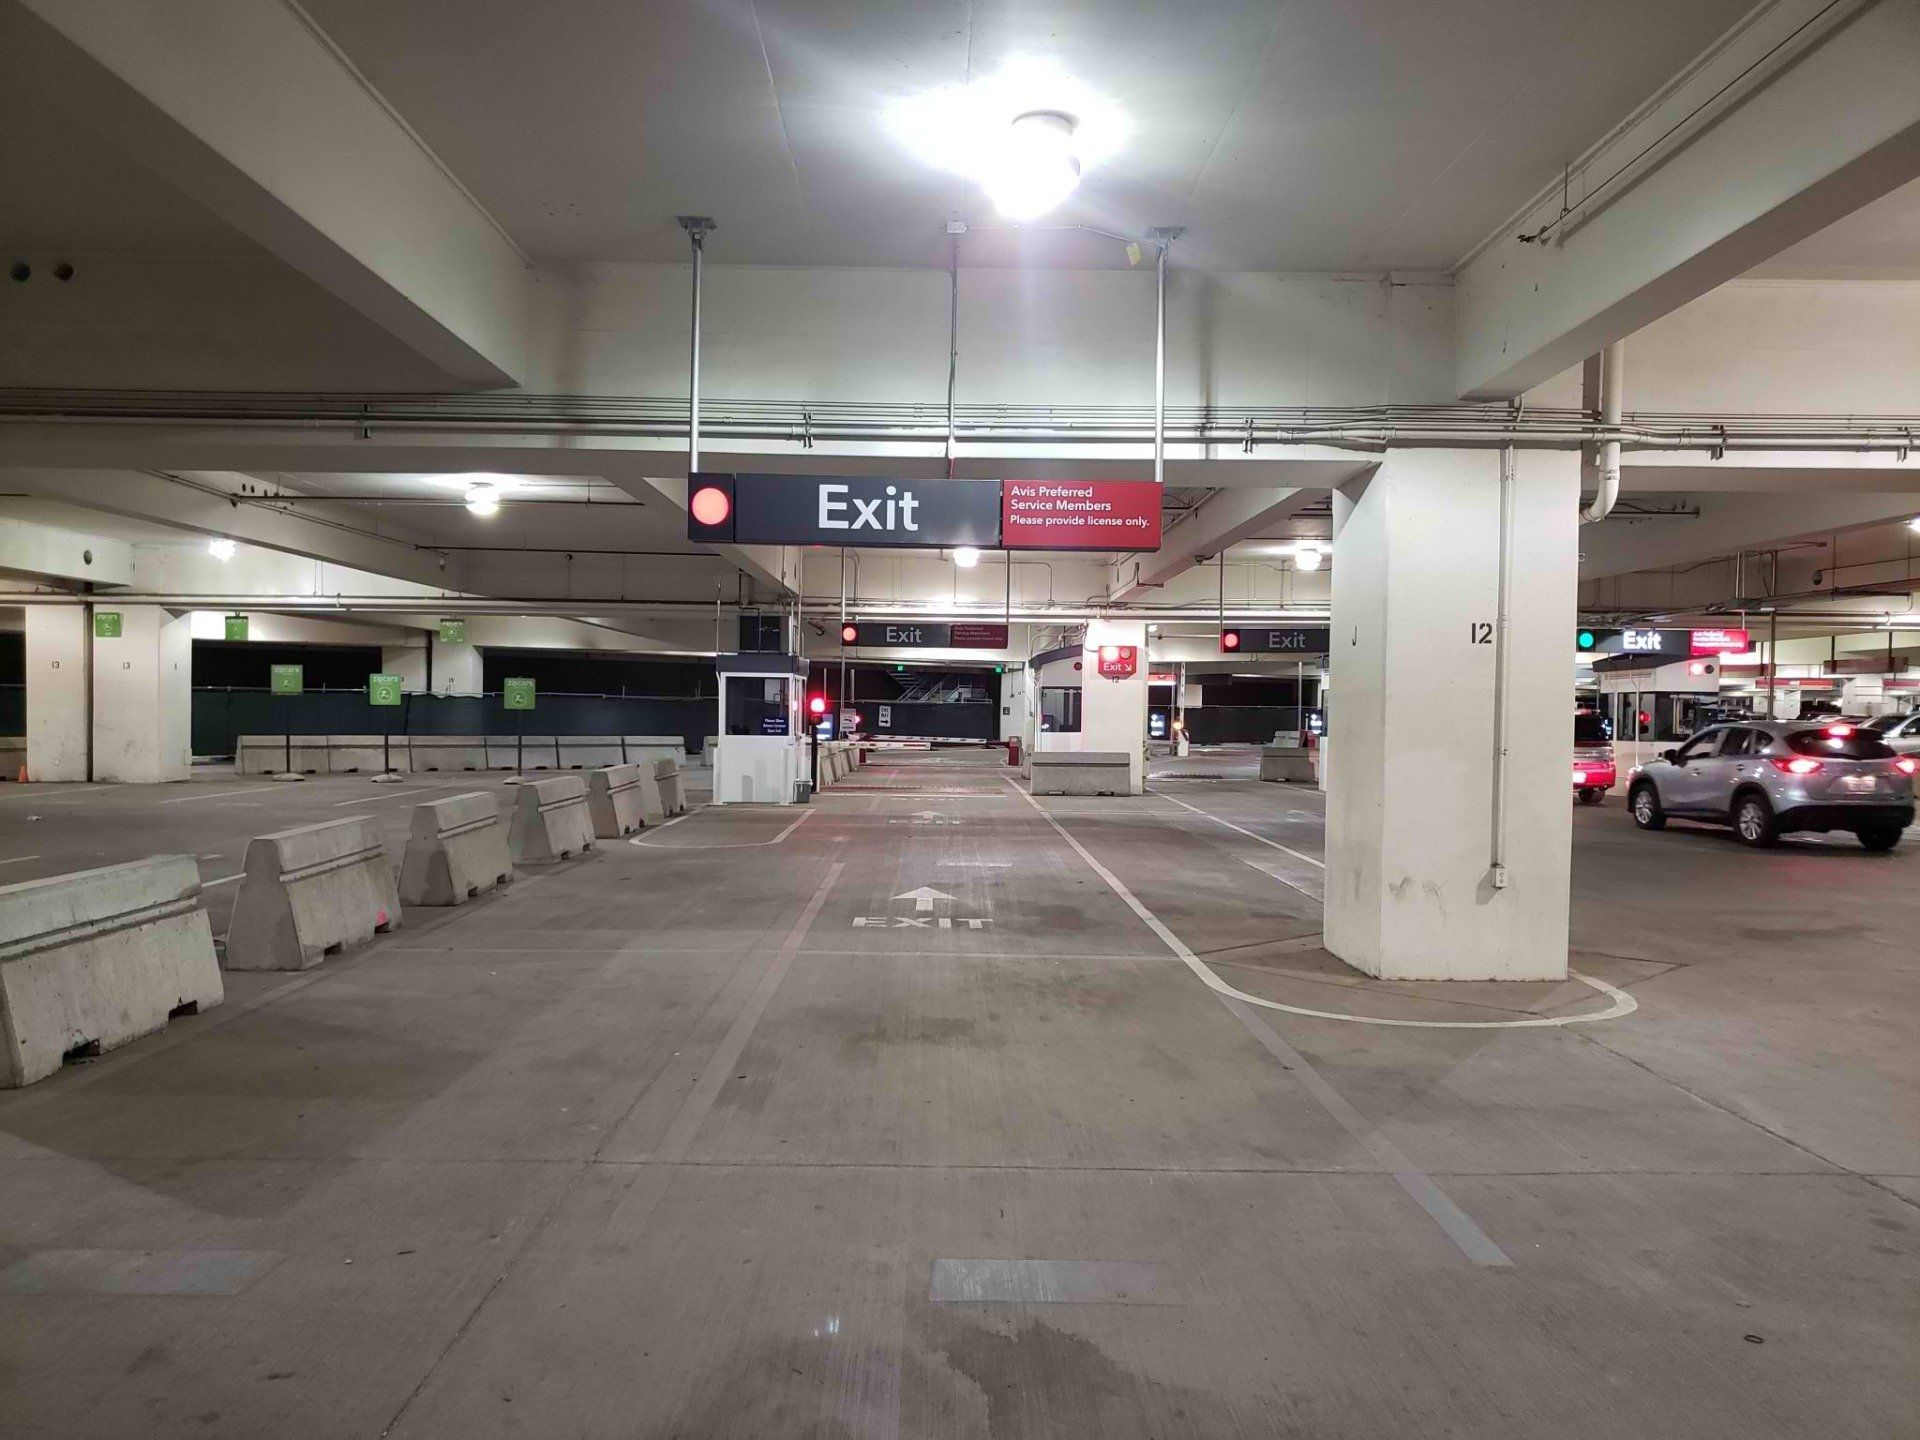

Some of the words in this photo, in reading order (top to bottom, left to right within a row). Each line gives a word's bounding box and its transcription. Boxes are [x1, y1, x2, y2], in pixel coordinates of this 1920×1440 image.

[1011, 486, 1036, 497] Avis
[1039, 486, 1093, 498] Preferred
[818, 484, 919, 531] Exit
[1011, 499, 1054, 510] Service
[1056, 500, 1112, 511] Members
[1010, 514, 1043, 525] Please
[1045, 515, 1085, 527] provide
[1088, 515, 1123, 526] license
[1125, 516, 1150, 528] only.
[886, 626, 922, 643] Exit
[1269, 631, 1306, 648] Exit
[1471, 622, 1493, 644] 12
[1623, 630, 1662, 650] Exit
[1103, 662, 1121, 671] Exit
[372, 675, 399, 684] zipcars
[1111, 675, 1120, 684] 12
[852, 916, 993, 929] EXIT
